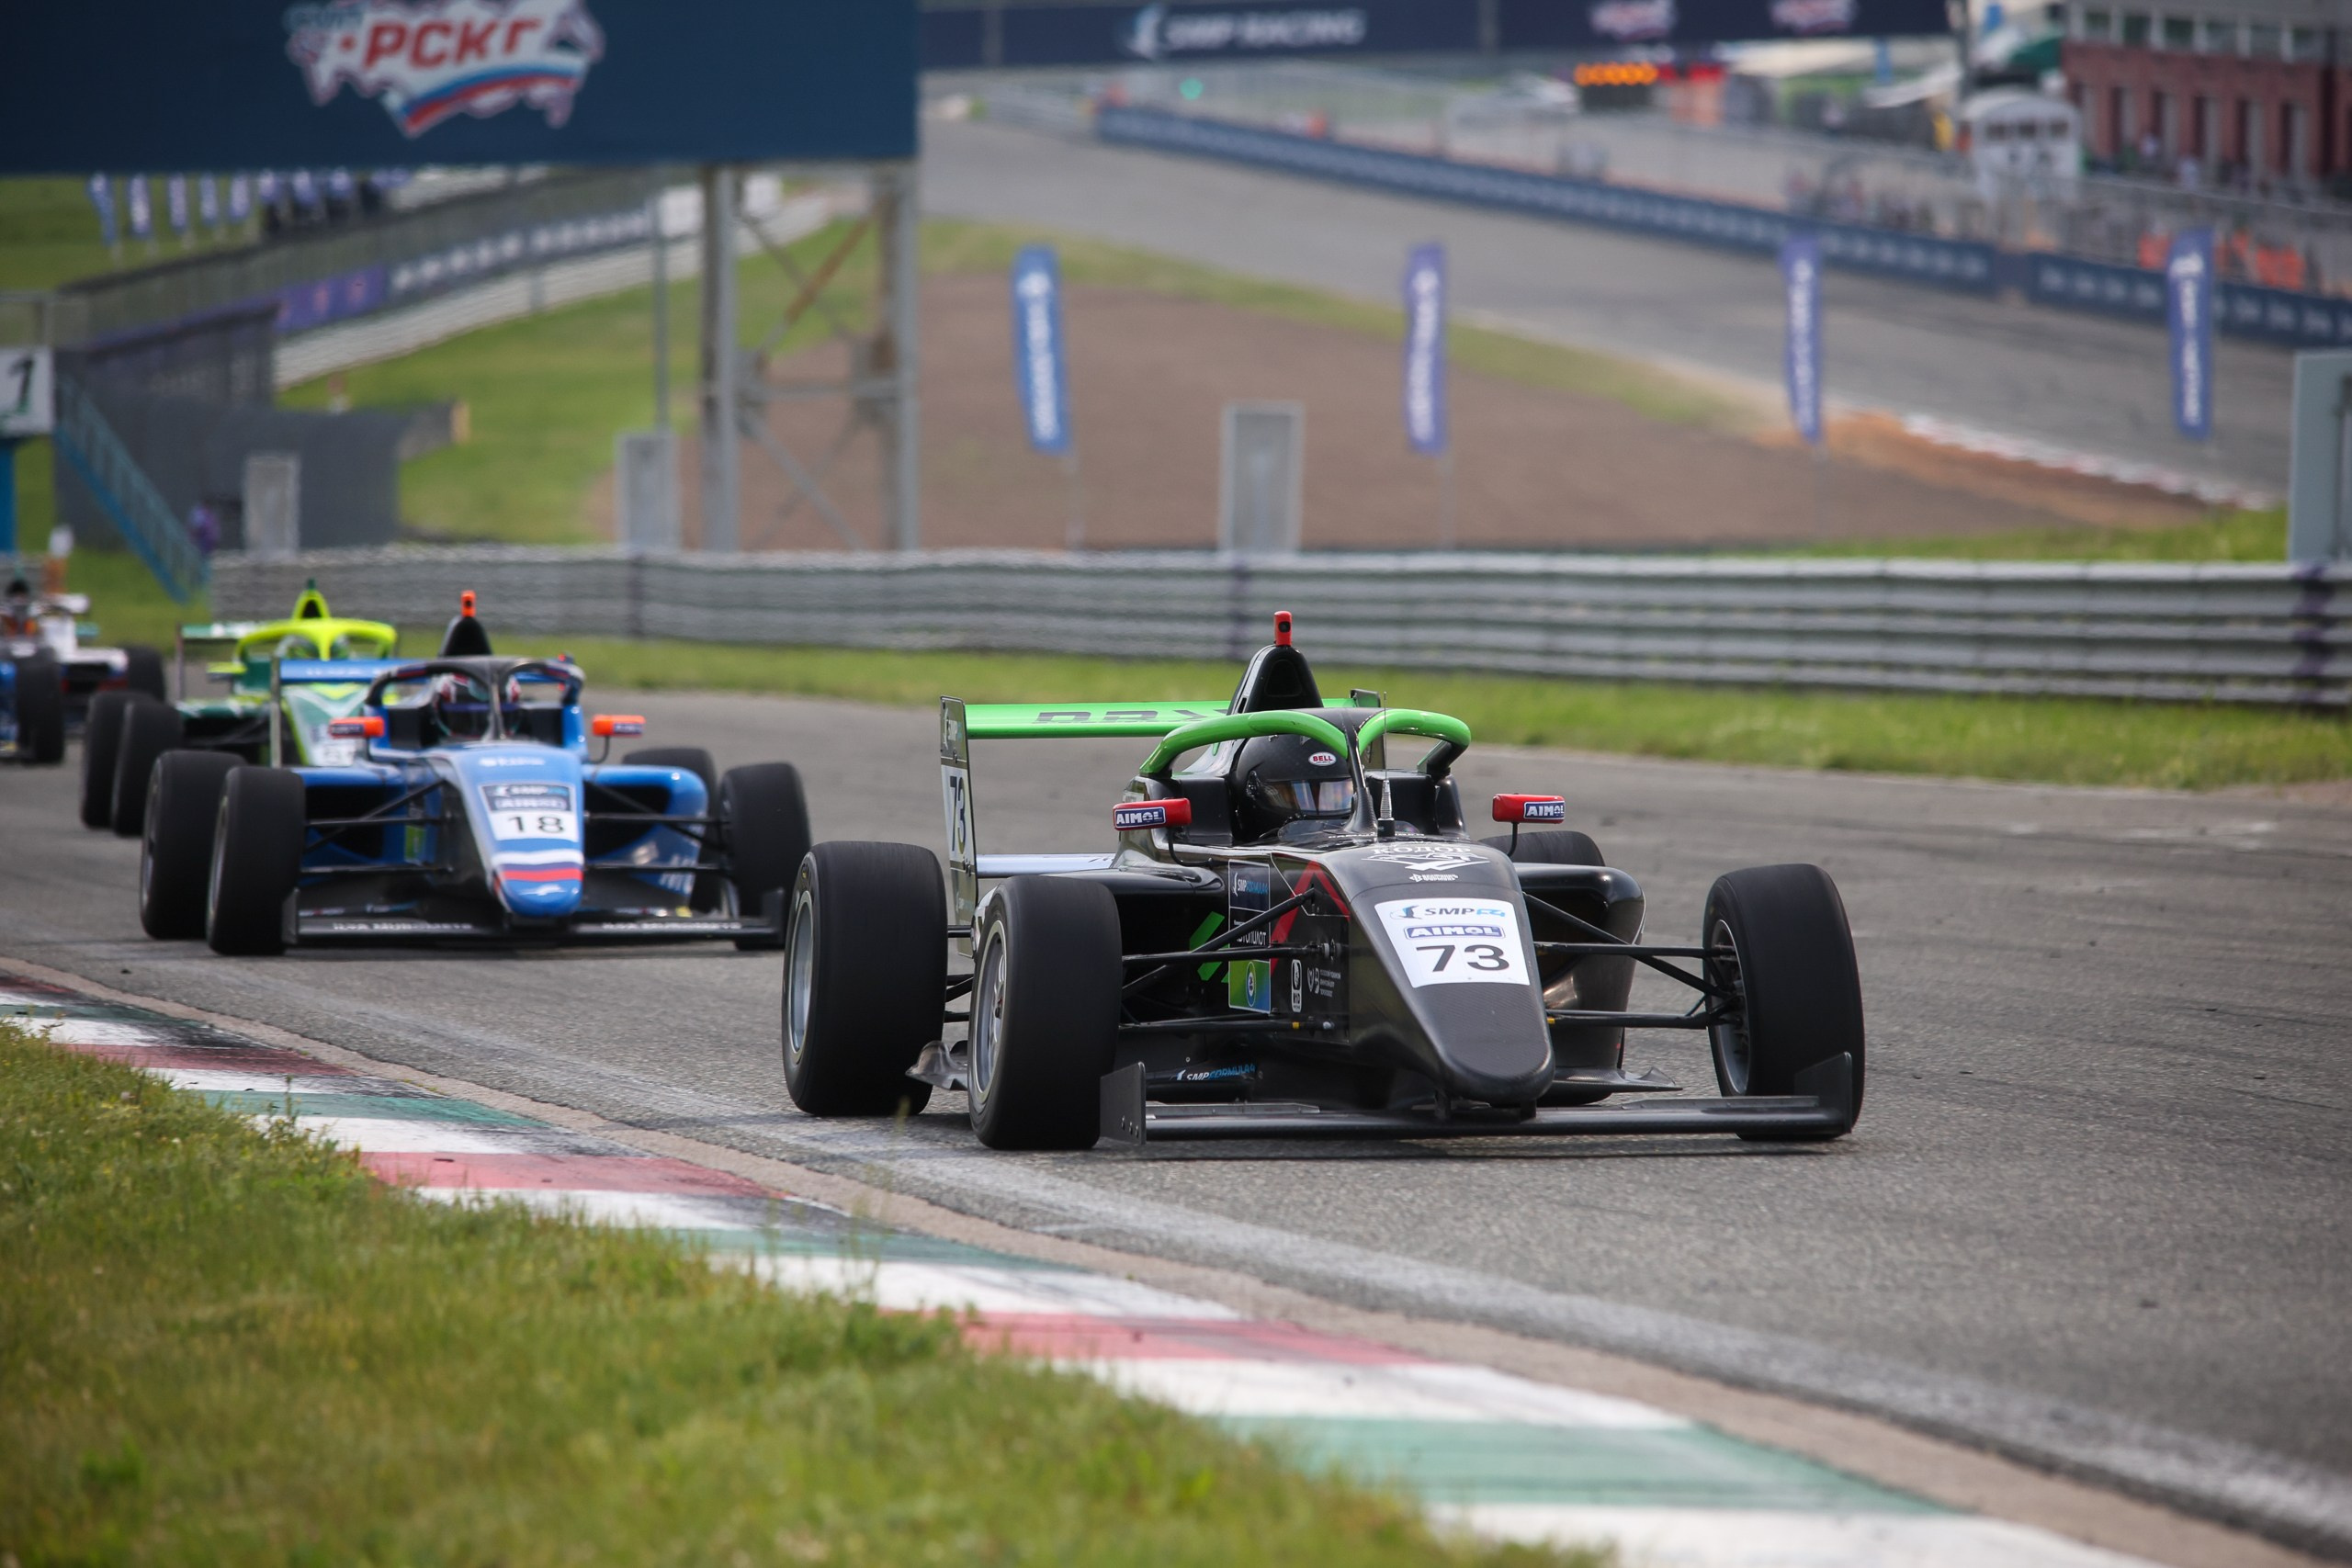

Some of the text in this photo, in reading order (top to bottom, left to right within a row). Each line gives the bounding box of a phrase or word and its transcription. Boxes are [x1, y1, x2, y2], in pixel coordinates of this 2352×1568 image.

[1243, 10, 1364, 45] RACING
[363, 17, 544, 71] РСКГ
[949, 775, 967, 855] 73
[1116, 811, 1164, 824] AIMOL
[1526, 805, 1565, 817] AIMOL
[508, 816, 564, 833] 18
[1410, 926, 1500, 937] AIMOL
[1416, 944, 1510, 973] 73
